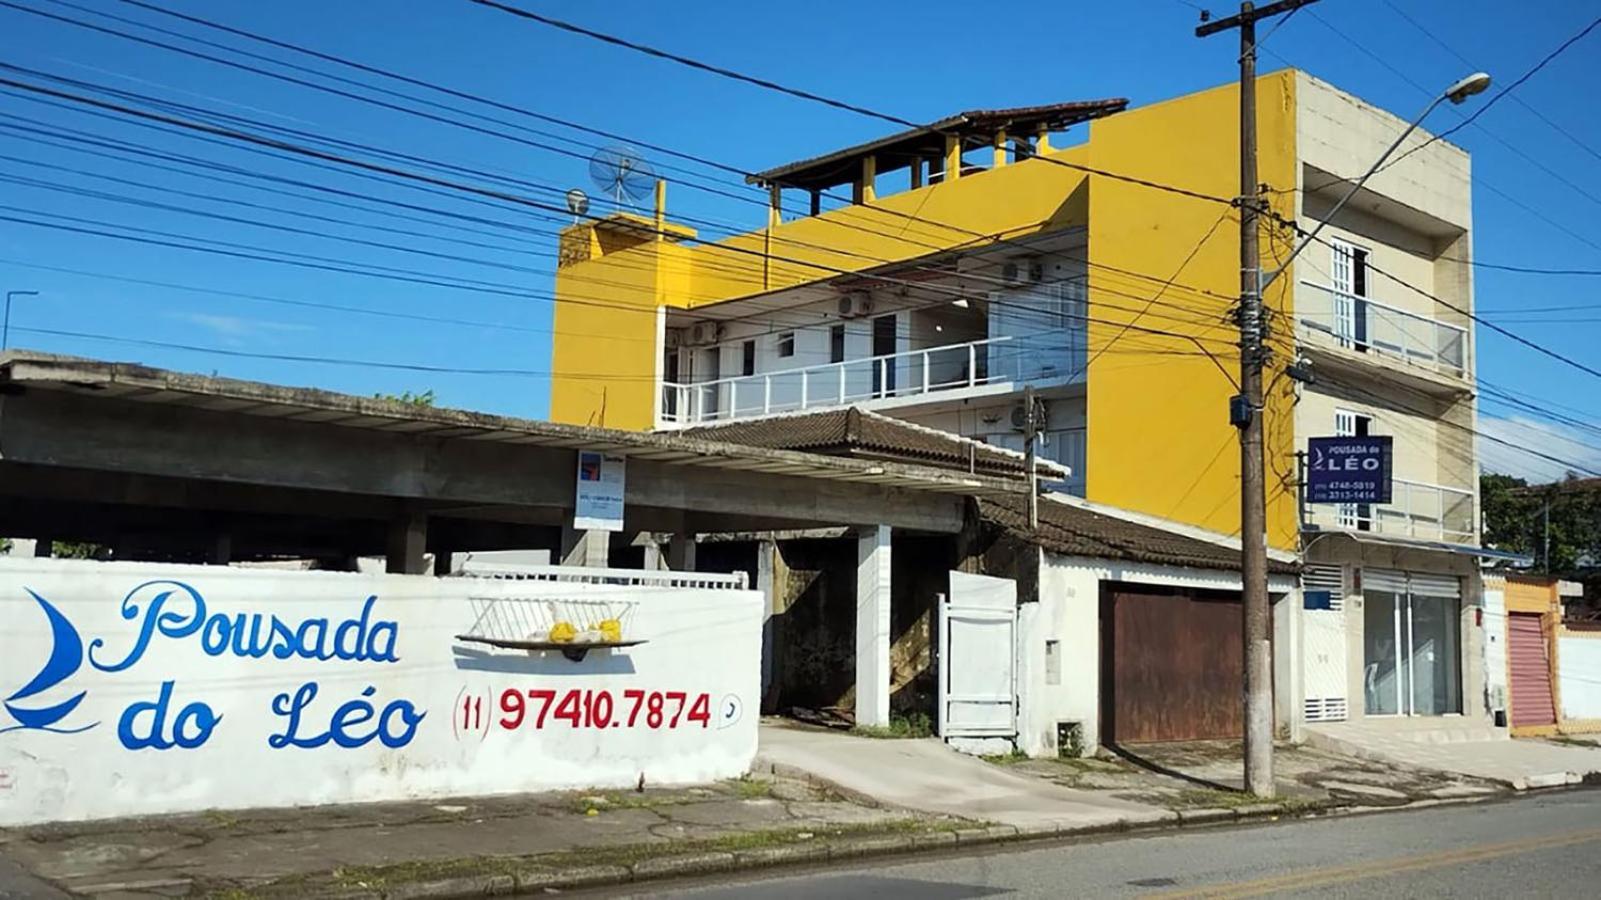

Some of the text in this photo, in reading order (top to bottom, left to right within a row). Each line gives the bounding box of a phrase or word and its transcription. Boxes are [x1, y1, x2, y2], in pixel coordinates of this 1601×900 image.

[1328, 445, 1368, 455] POUSADA
[1328, 455, 1379, 471] LÉO
[89, 580, 399, 672] Pousada
[117, 680, 427, 751] do Léo
[453, 685, 711, 742] (11) 97410.7874
